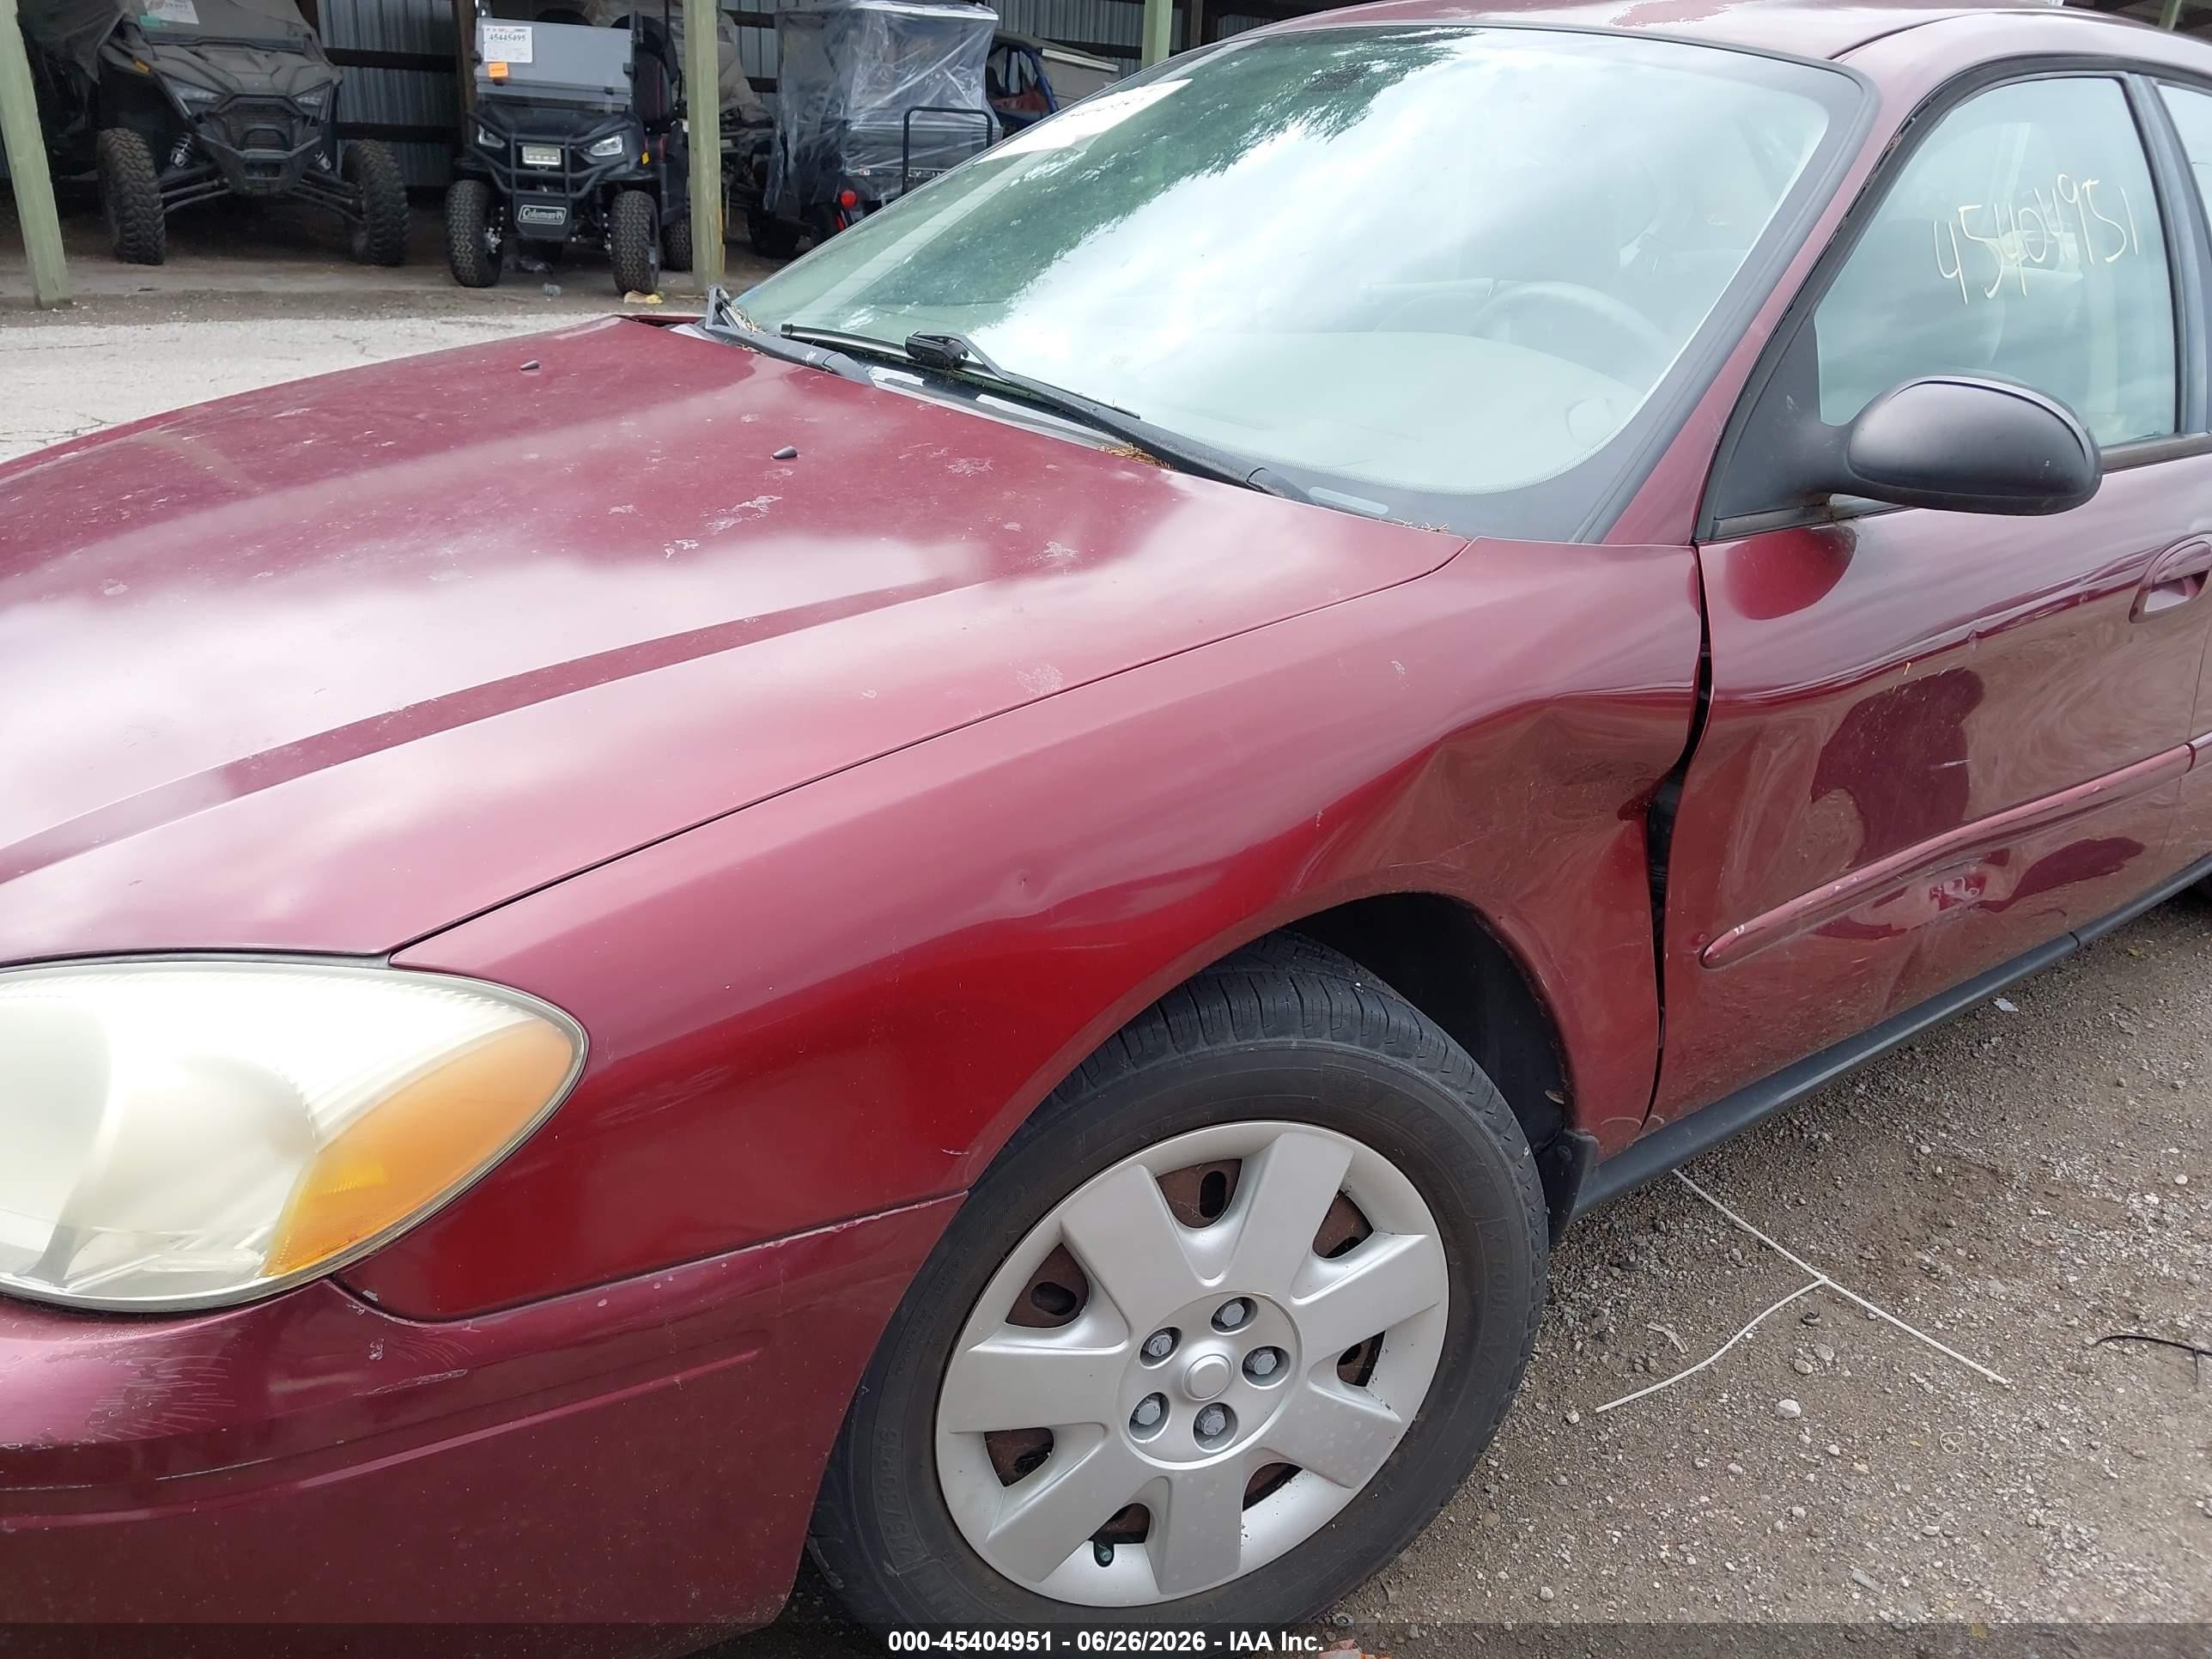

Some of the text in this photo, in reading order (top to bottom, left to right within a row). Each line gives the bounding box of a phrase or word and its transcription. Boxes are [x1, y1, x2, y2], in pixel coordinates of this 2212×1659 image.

[489, 33, 526, 42] 45445495
[522, 207, 556, 220] Coleman
[1933, 173, 2139, 305] 45404951
